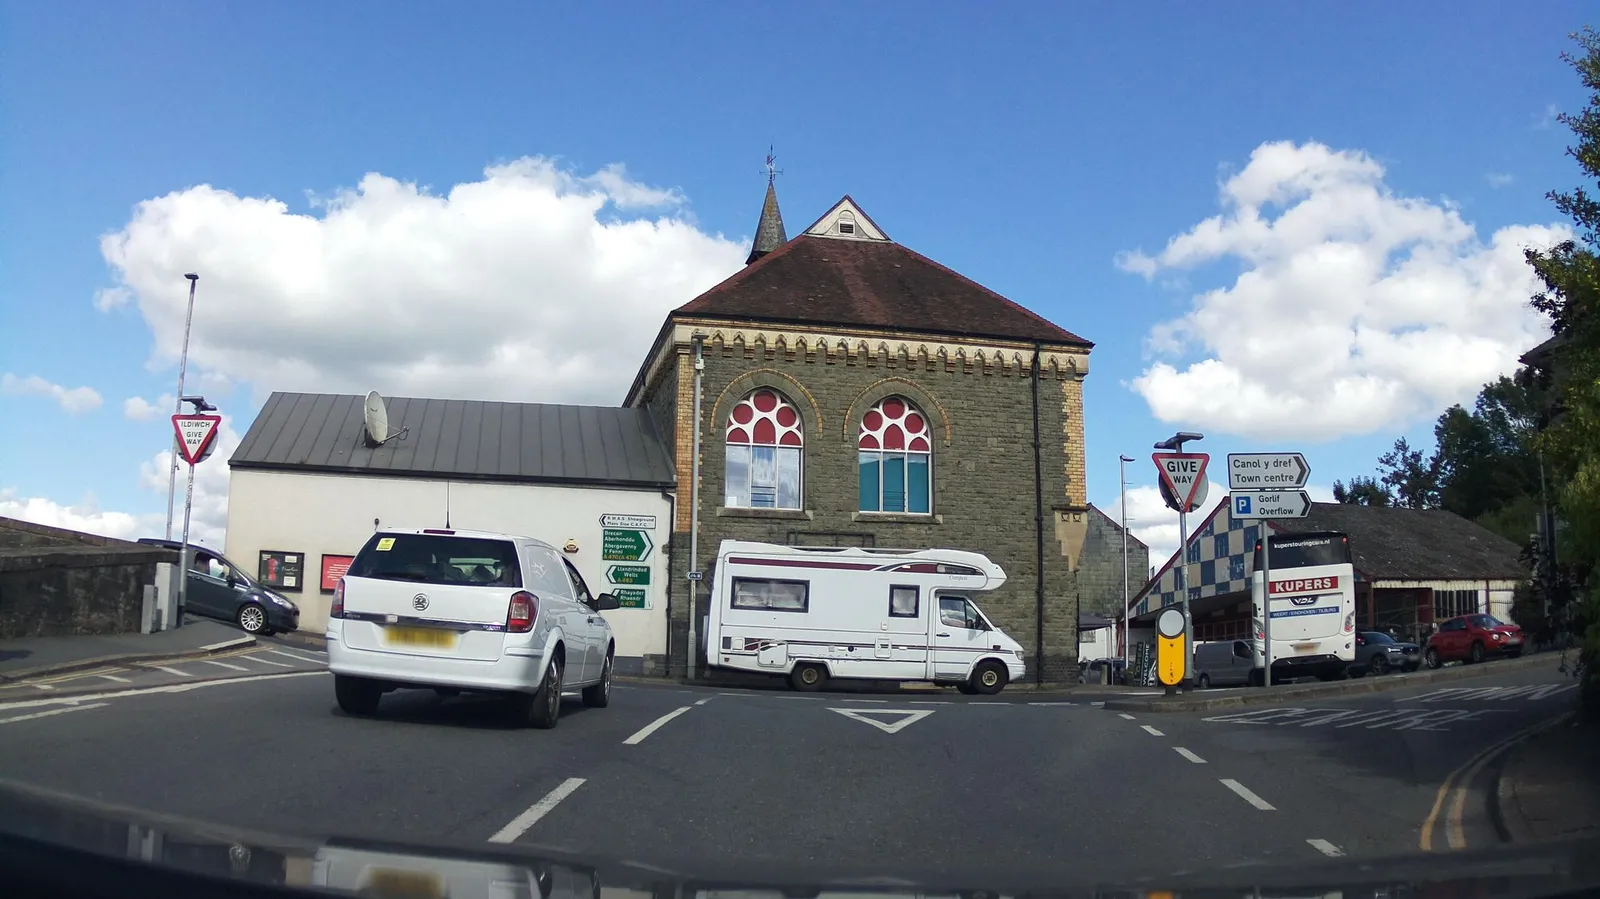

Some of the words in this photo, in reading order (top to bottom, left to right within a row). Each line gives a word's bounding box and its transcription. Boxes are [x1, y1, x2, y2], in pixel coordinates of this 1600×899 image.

[1166, 461, 1197, 472] GIVE
[1233, 459, 1261, 468] Canol
[1264, 460, 1270, 470] y
[1273, 458, 1292, 468] dref
[1173, 475, 1192, 484] WAY
[1234, 474, 1260, 483] Town
[1264, 474, 1294, 482] centre
[1258, 495, 1280, 503] Gorlif
[1238, 500, 1246, 511] P
[1259, 507, 1294, 515] Overflow
[1275, 578, 1331, 592] KUPERS
[1201, 708, 1518, 731] CENTRE
